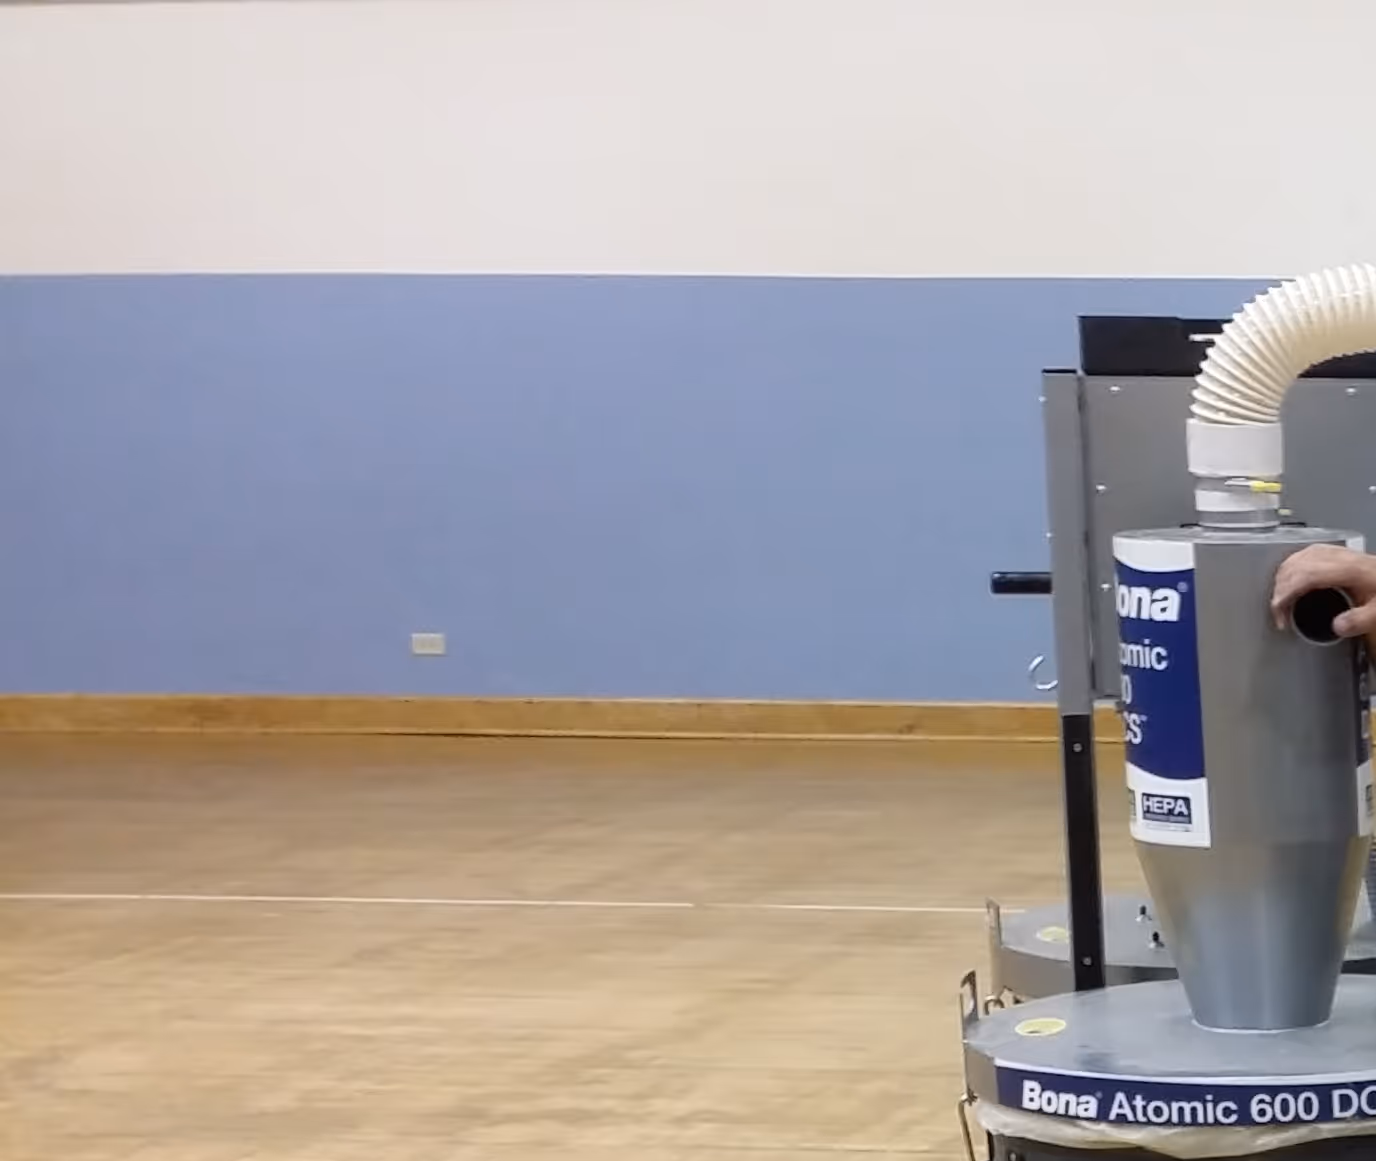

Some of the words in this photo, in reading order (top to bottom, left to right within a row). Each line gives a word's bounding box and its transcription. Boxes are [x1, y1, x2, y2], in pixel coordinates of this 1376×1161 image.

[1116, 585, 1181, 622] ona
[1143, 795, 1189, 816] HEPA
[1021, 1079, 1099, 1119] Bona
[1108, 1090, 1239, 1125] Atomic
[1250, 1091, 1319, 1124] 600
